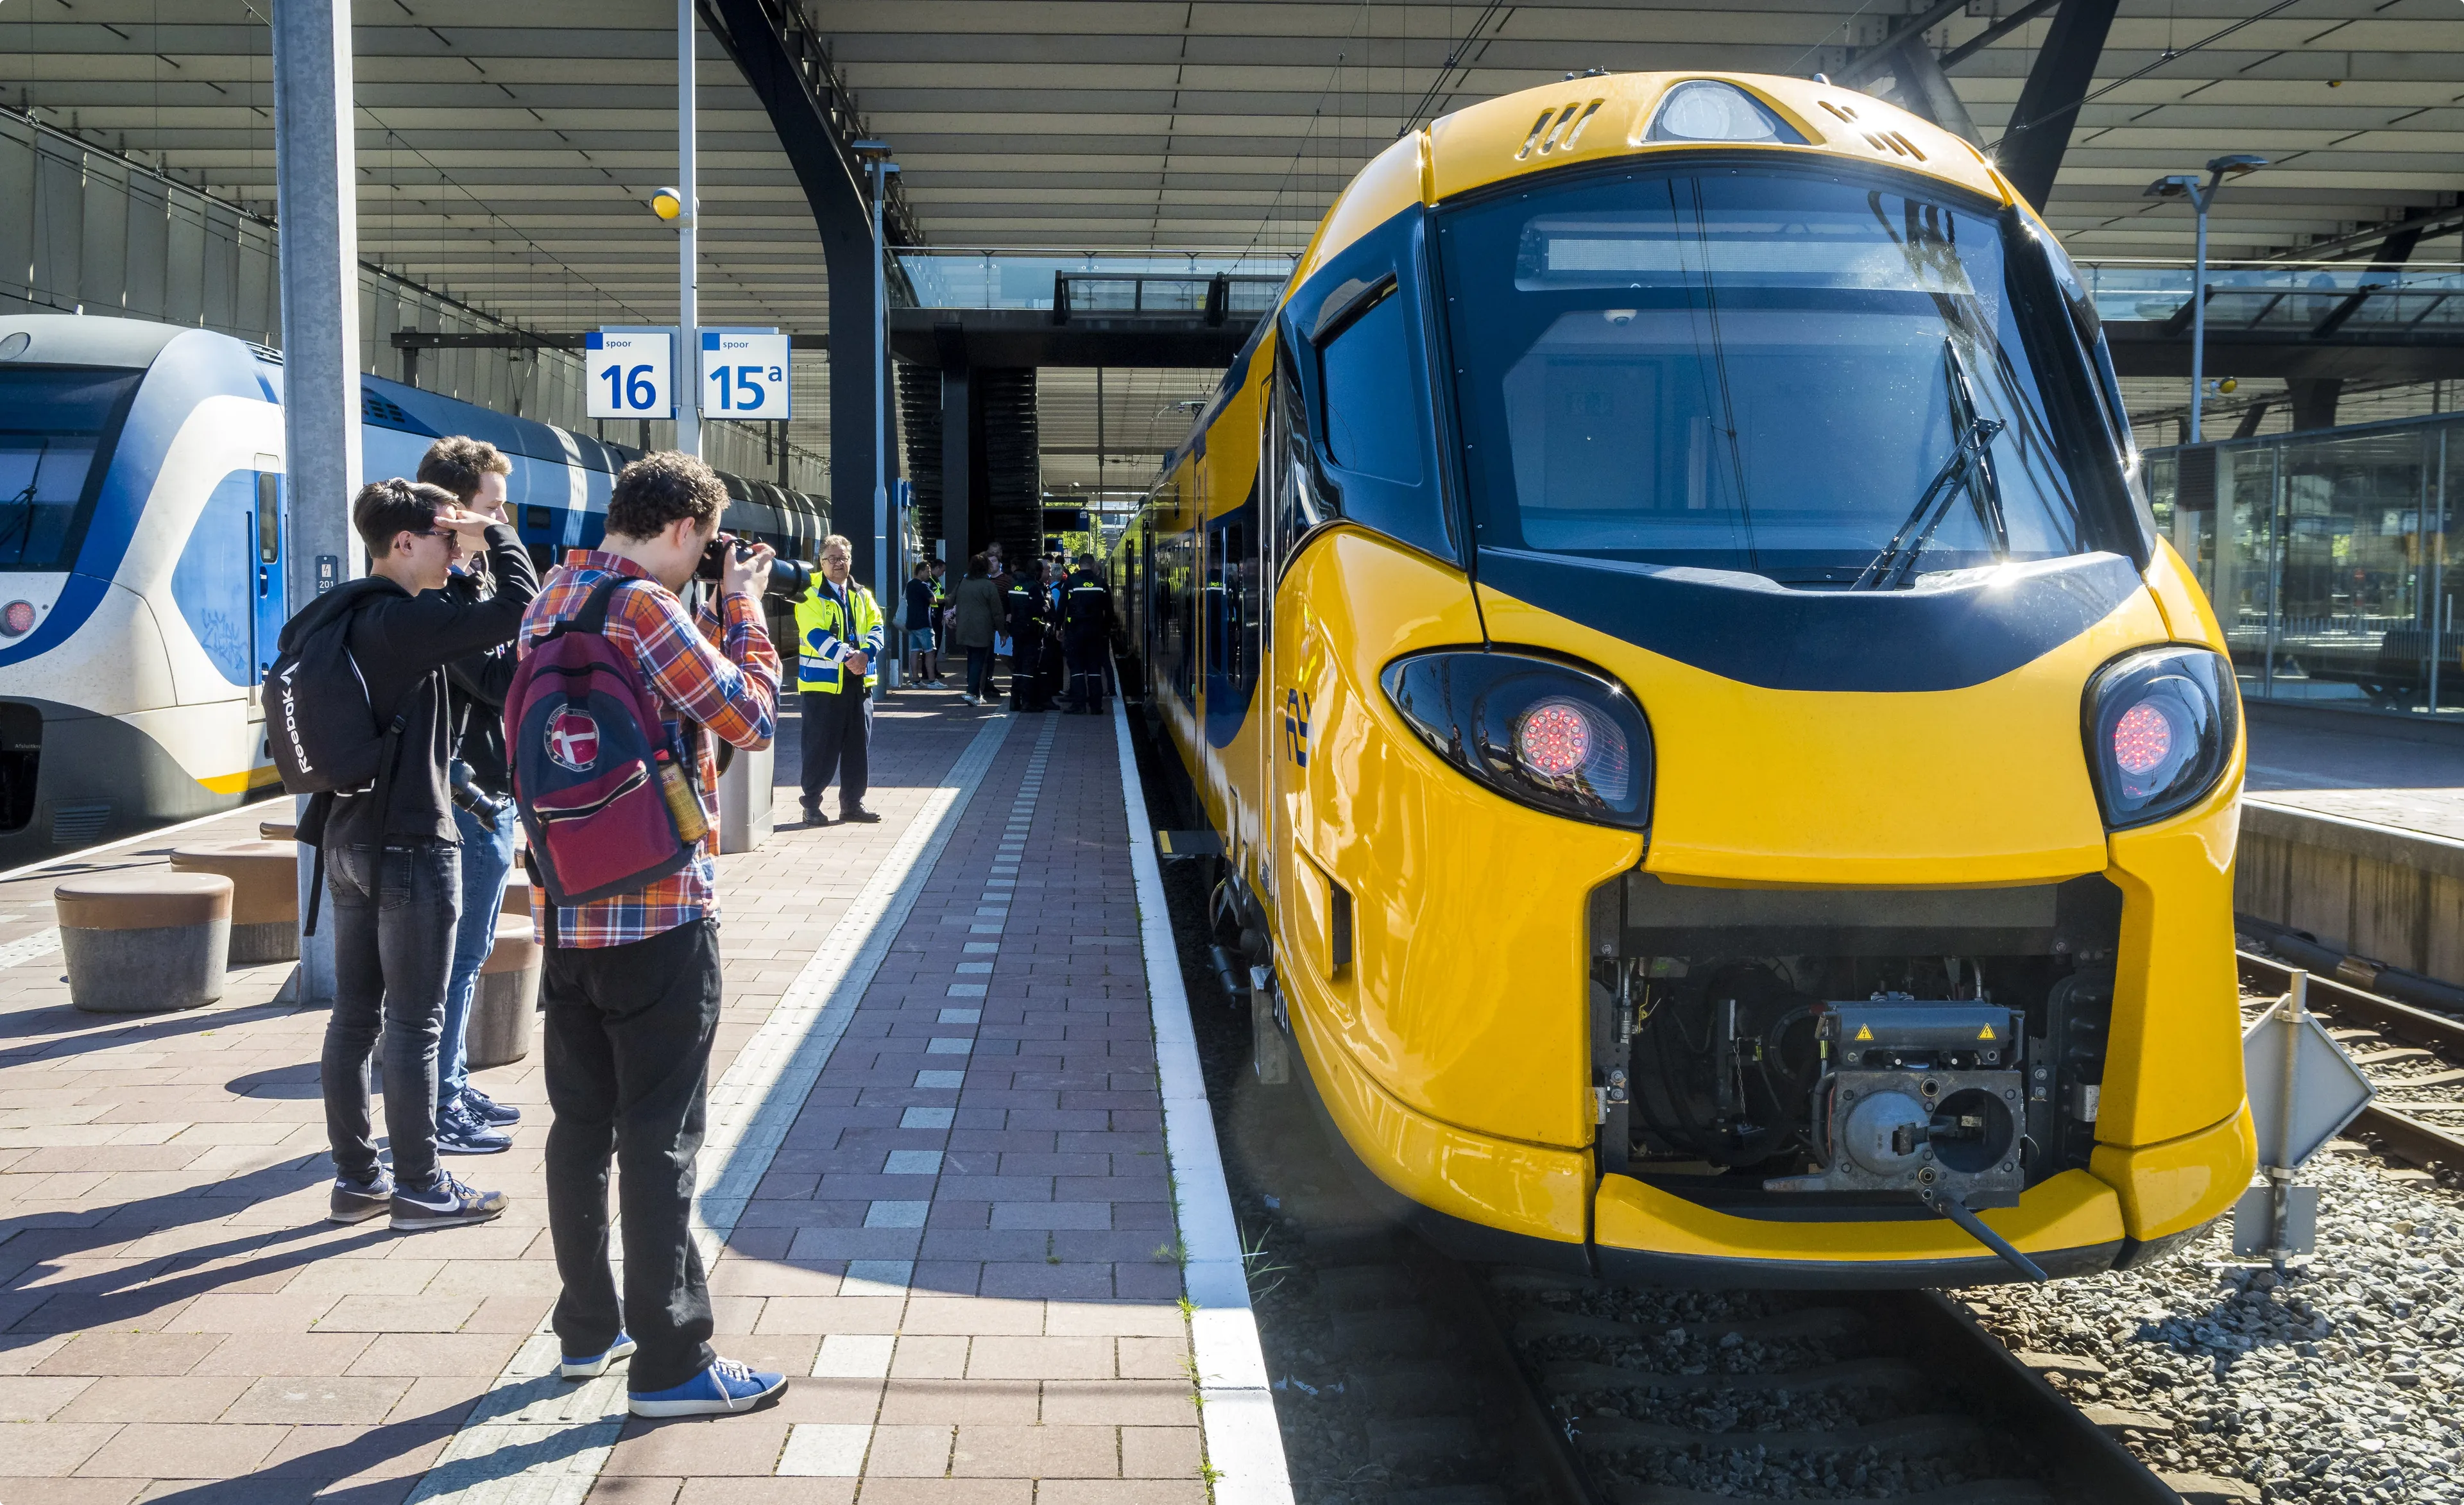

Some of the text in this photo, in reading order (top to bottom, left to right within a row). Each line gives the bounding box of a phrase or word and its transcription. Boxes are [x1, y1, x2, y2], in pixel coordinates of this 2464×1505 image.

[606, 339, 632, 348] spoor
[723, 340, 749, 350] spoor
[601, 364, 656, 411] 16
[709, 365, 783, 411] 15a
[282, 687, 313, 774] Reebok
[1274, 979, 1288, 1034] 3121
